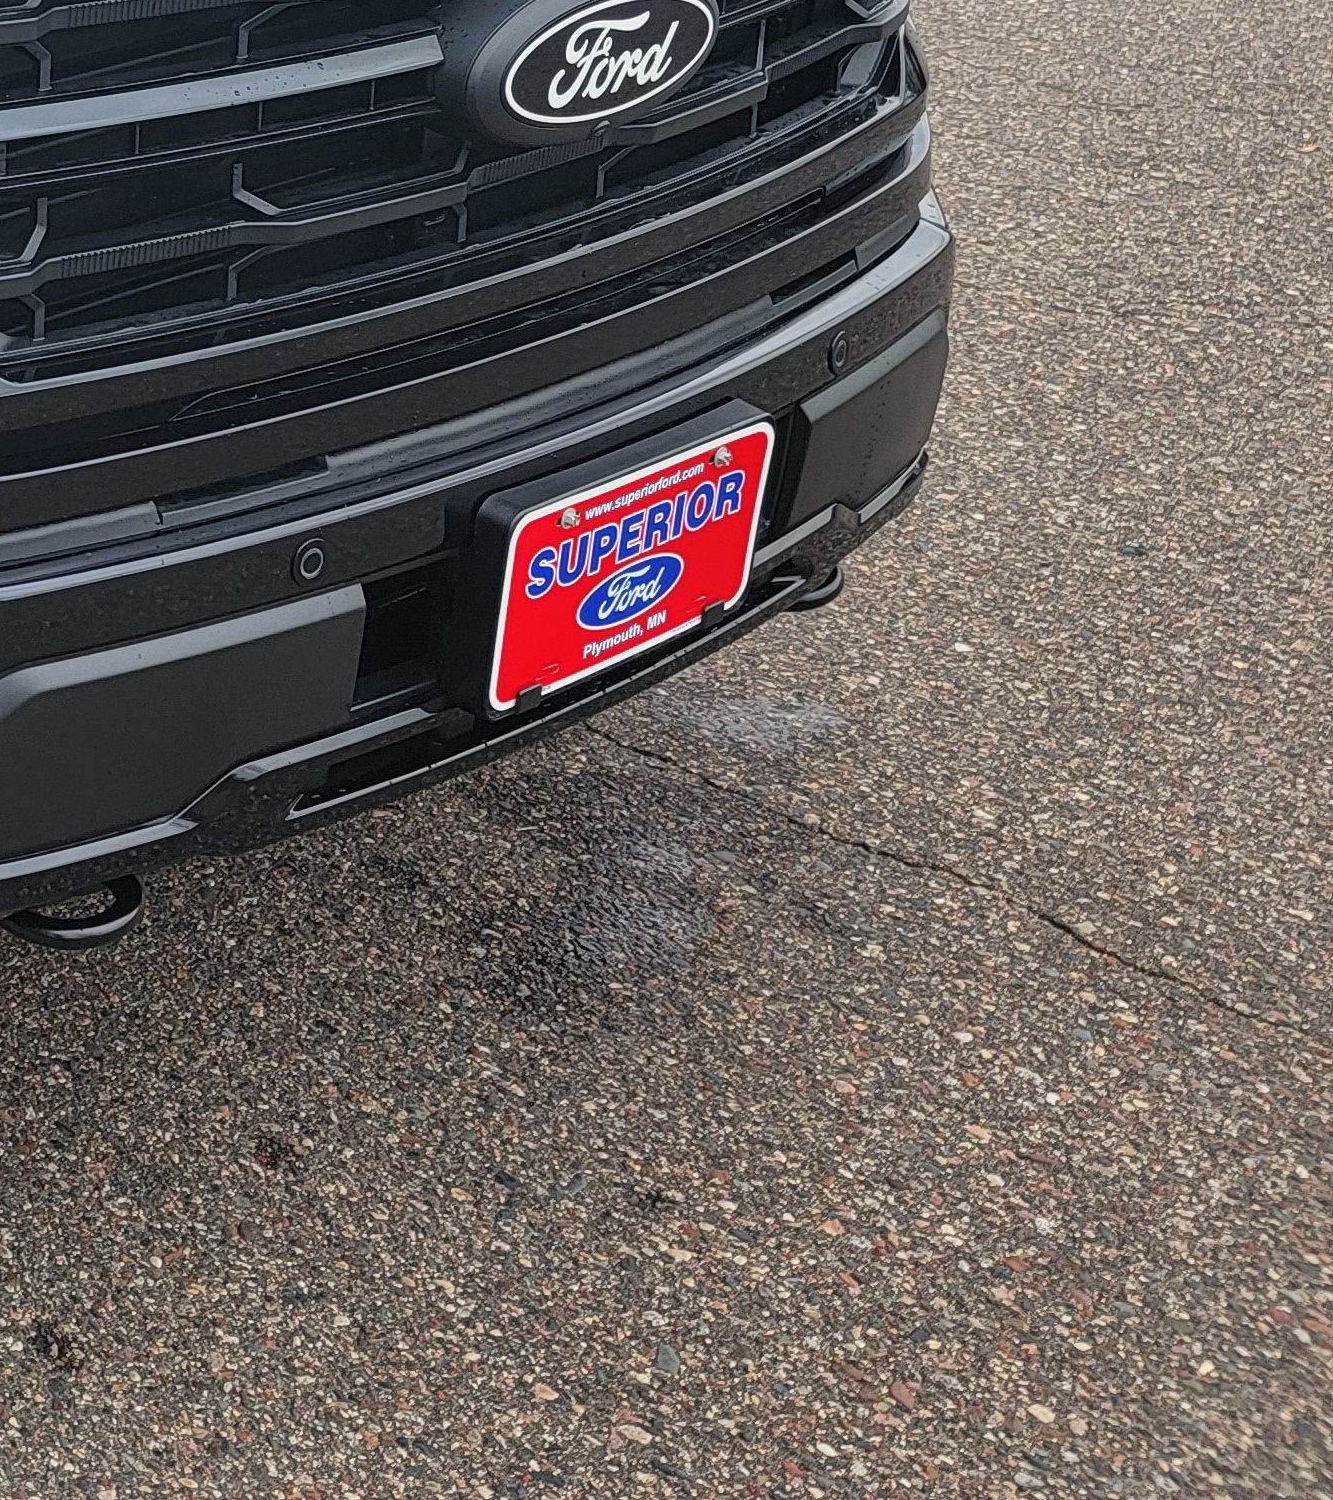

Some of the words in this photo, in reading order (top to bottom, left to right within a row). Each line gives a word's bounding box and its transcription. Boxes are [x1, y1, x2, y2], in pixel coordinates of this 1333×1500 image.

[547, 9, 680, 110] Ford
[584, 463, 705, 520] www.superiorford.com
[525, 469, 745, 599] SUPERIOR
[597, 564, 666, 620] Ford
[582, 623, 643, 659] Plymouth,
[646, 609, 667, 630] MN
